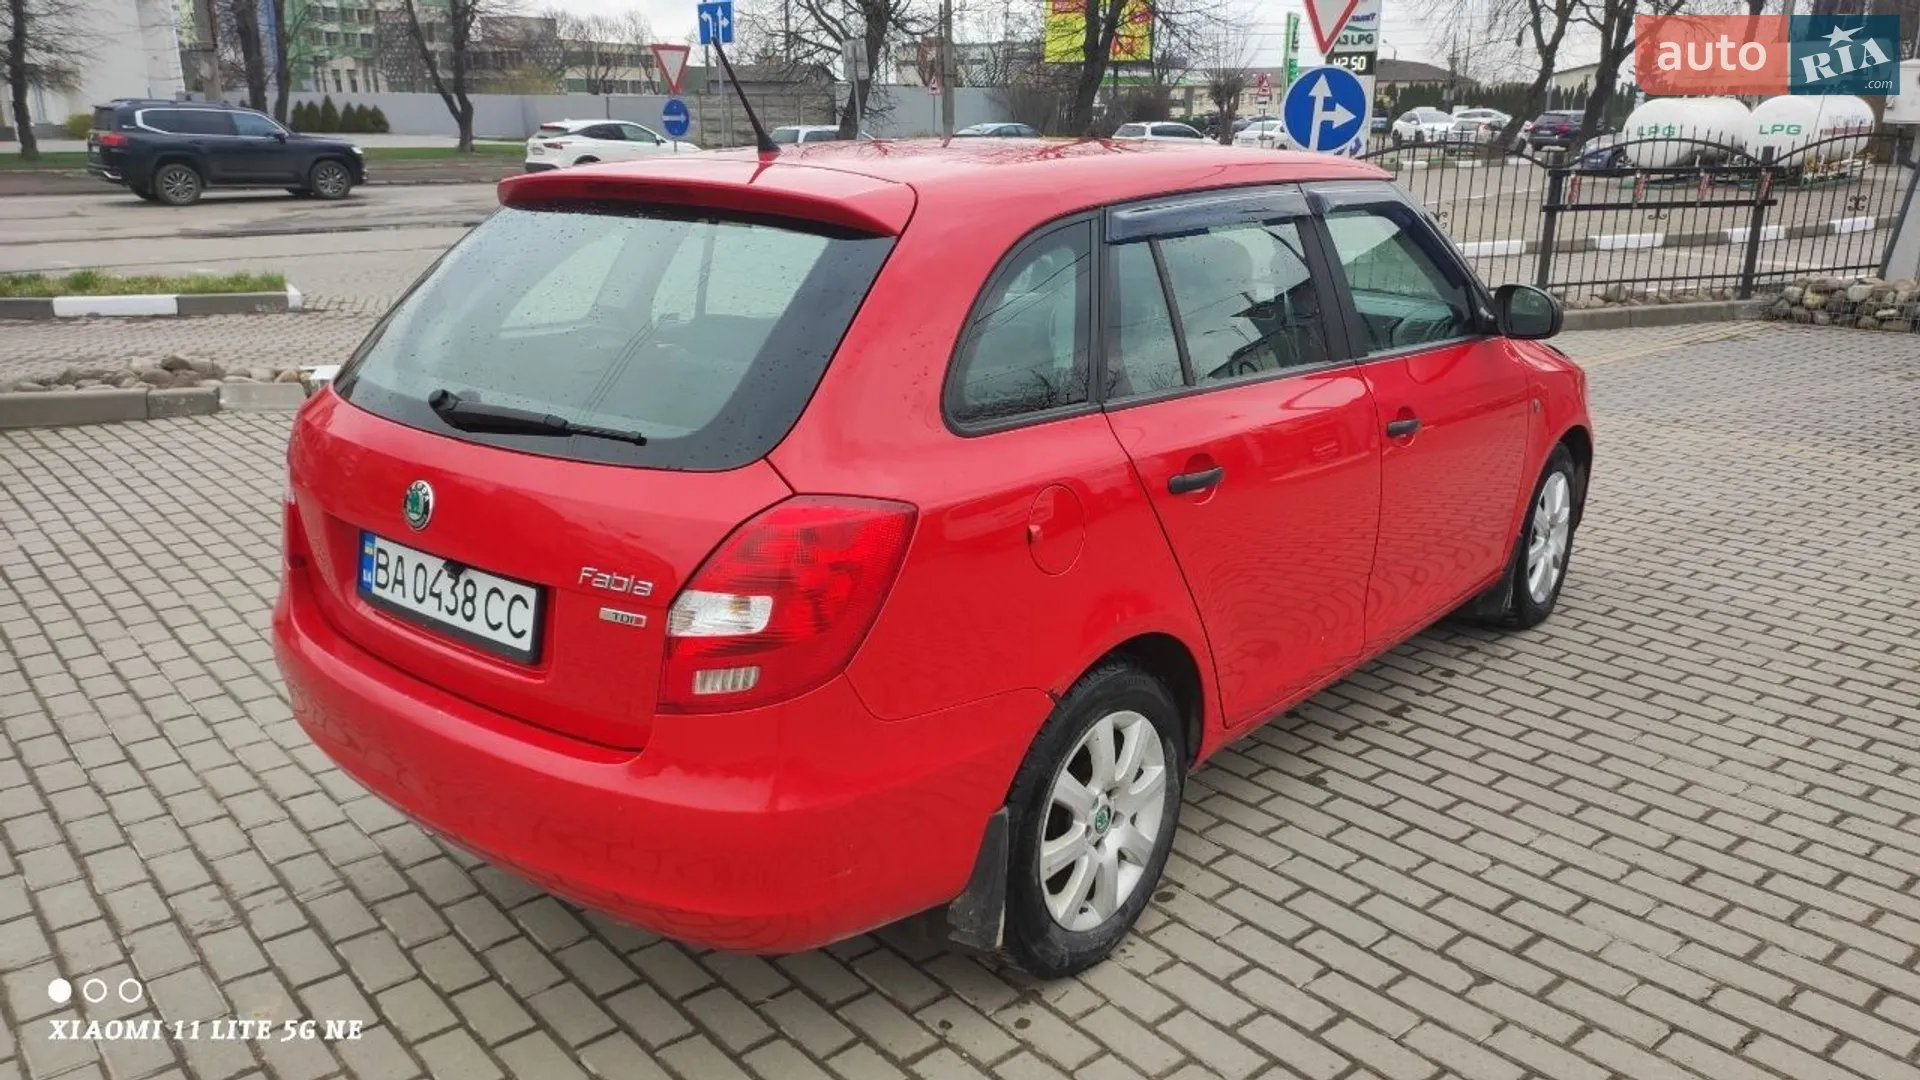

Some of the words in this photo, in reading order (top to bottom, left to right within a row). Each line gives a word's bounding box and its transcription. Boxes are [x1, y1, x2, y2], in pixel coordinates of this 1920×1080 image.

[1351, 33, 1374, 45] LPG
[1637, 126, 1676, 136] LPG
[1759, 124, 1802, 135] LPG
[578, 566, 653, 597] Fabia
[374, 547, 406, 599] BA
[413, 562, 478, 623] 0438
[484, 586, 530, 640] CC
[611, 611, 634, 625] TDI
